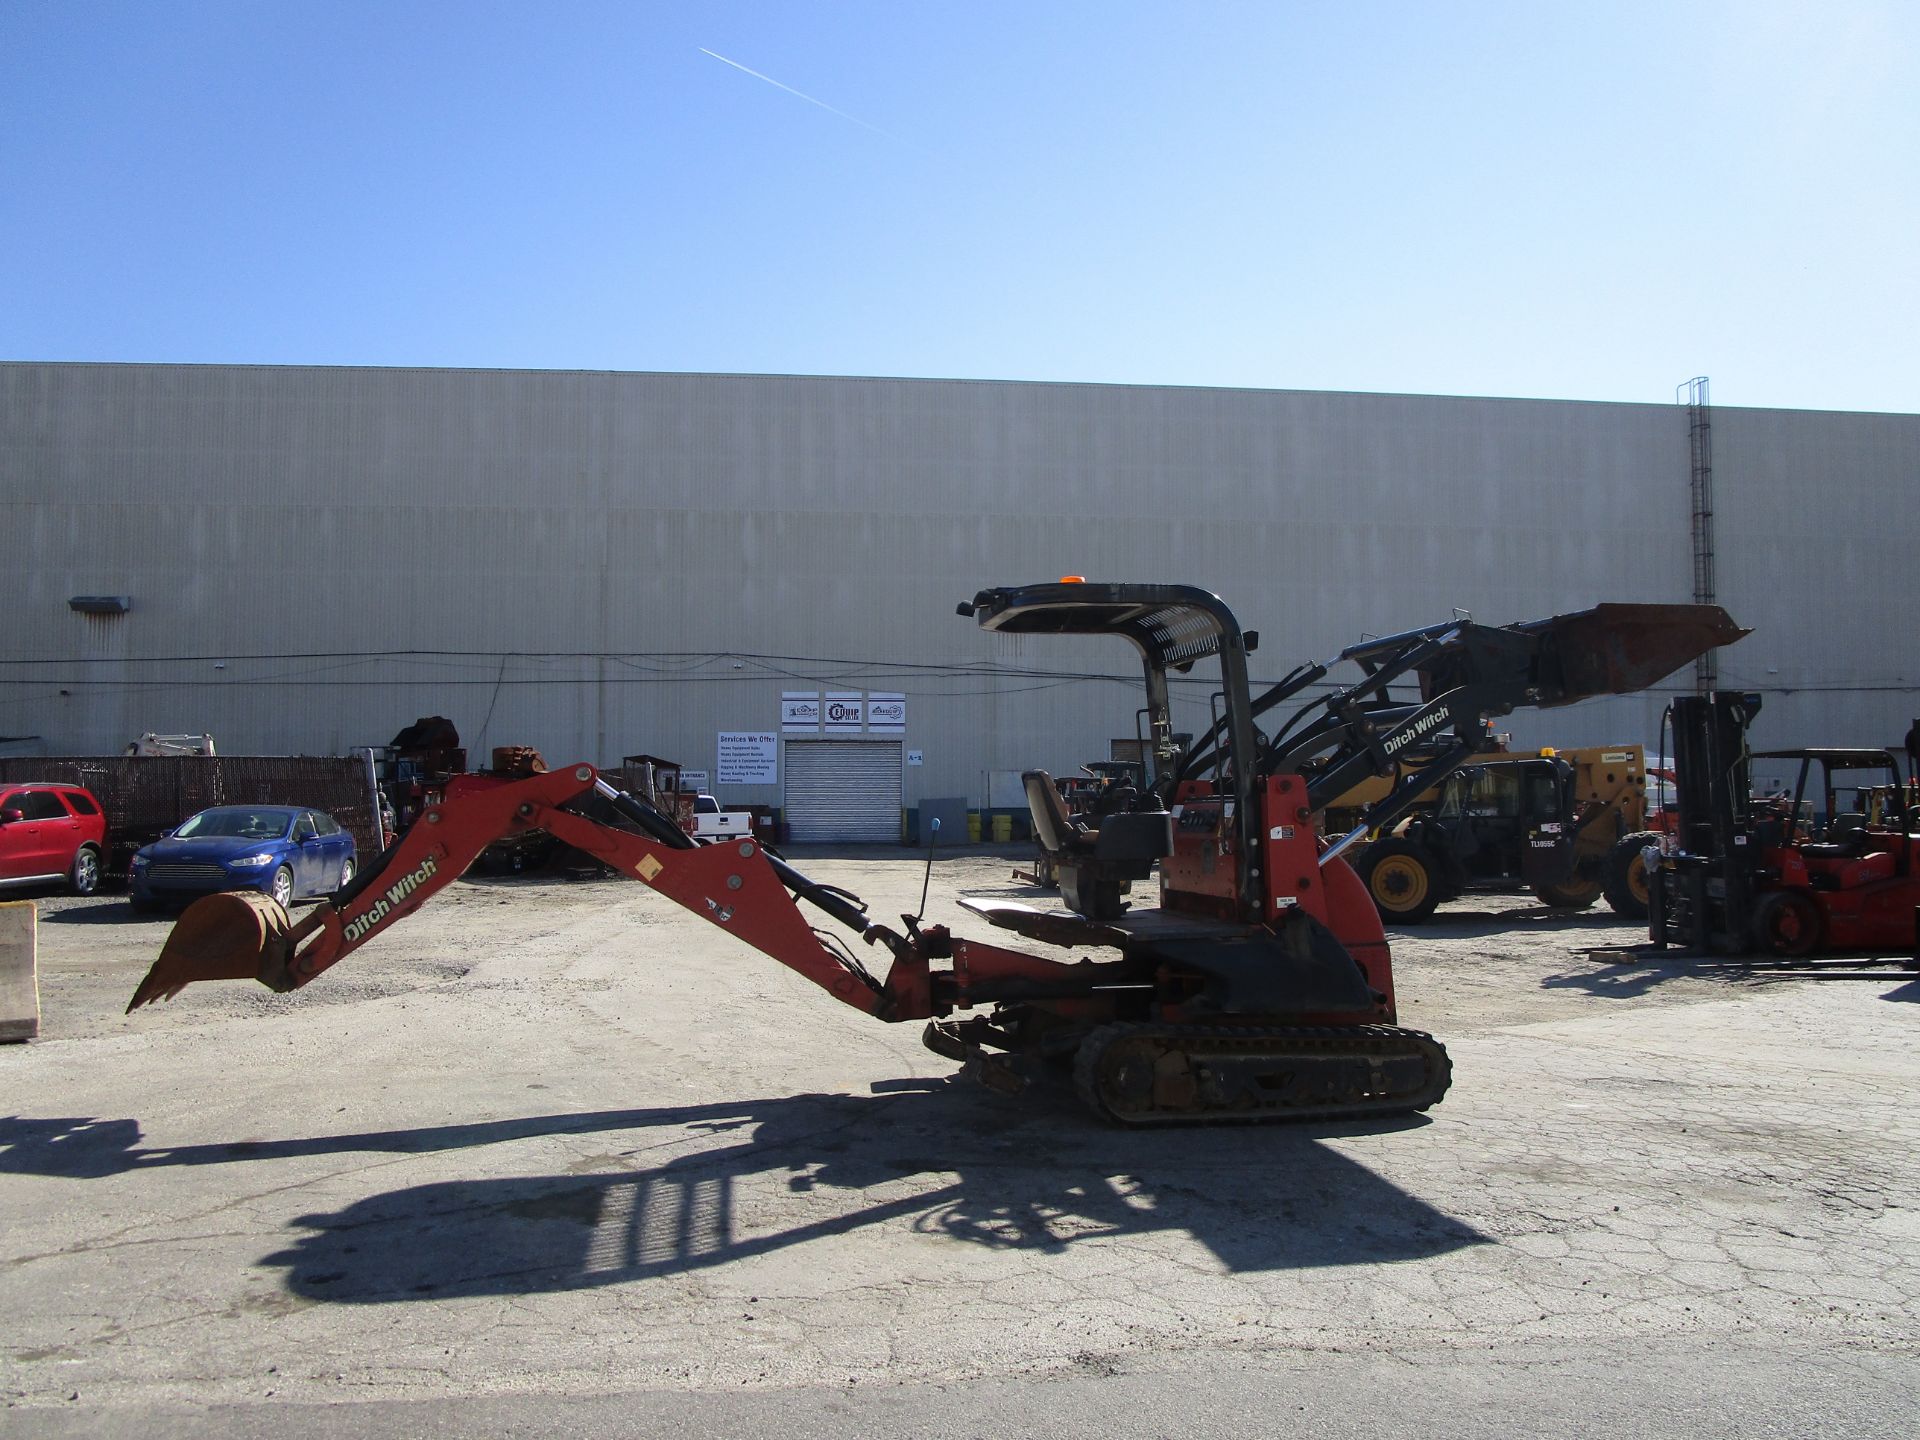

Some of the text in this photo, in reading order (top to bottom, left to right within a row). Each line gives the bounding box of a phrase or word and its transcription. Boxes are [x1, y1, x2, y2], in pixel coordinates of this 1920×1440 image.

[1383, 706, 1449, 755] Ditch Witch
[343, 860, 437, 941] Ditch Witch
